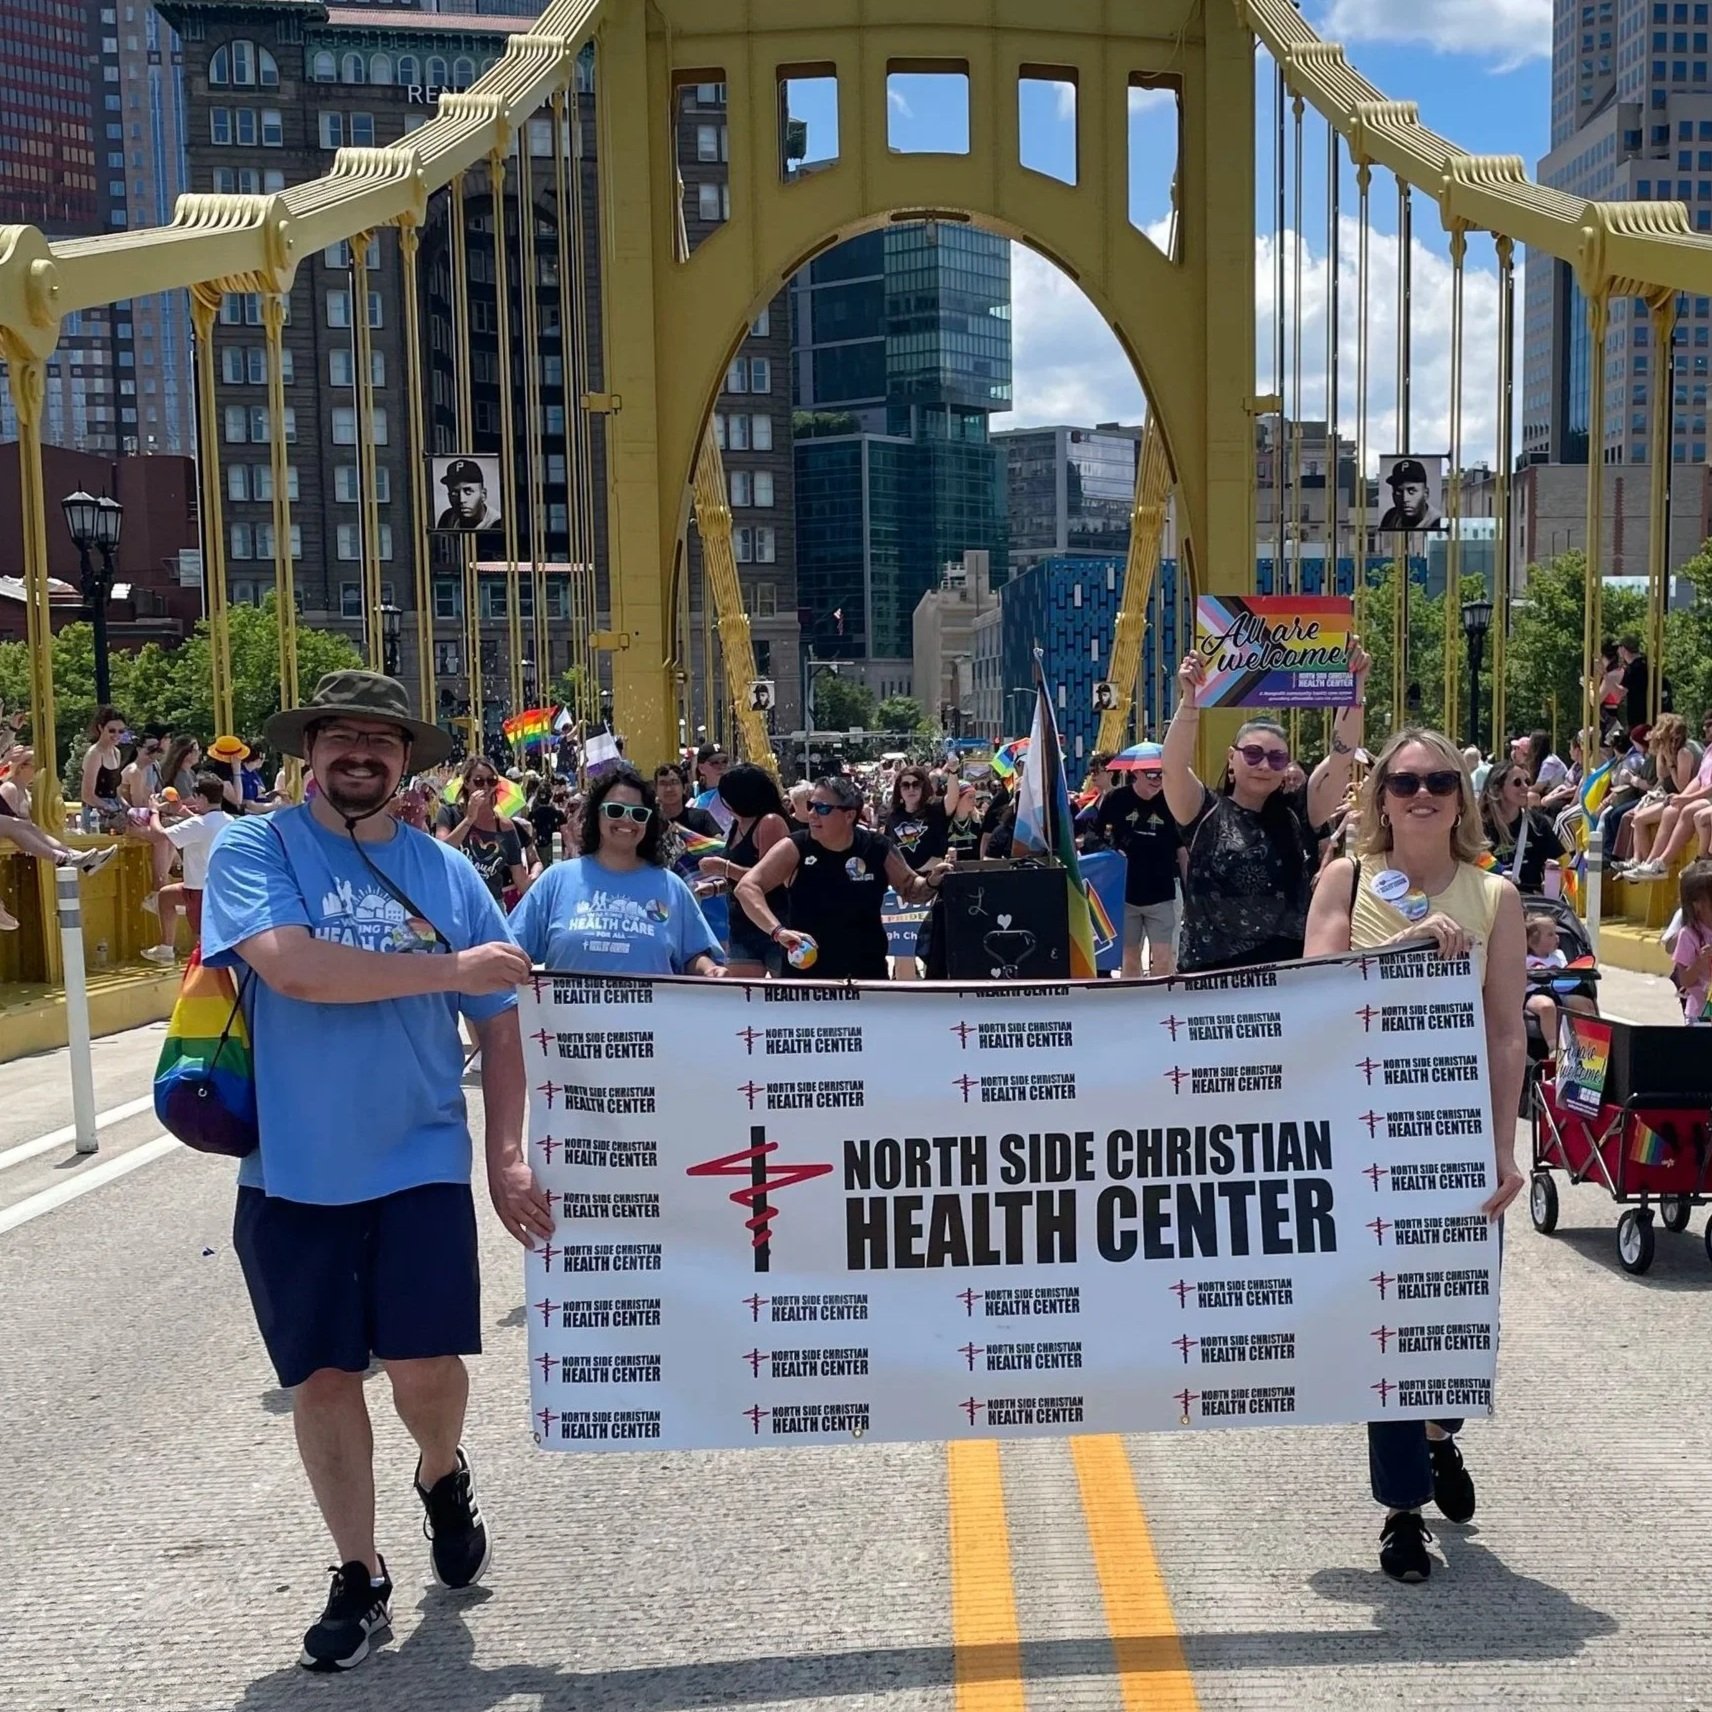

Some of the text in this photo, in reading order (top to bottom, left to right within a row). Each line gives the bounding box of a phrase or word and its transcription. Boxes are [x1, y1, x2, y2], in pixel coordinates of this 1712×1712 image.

[1201, 611, 1320, 655] All are
[1217, 631, 1351, 672] welcome!
[1298, 679, 1353, 687] HEALTH CENTER
[569, 917, 655, 937] HEALTH CARE
[1379, 954, 1406, 966] NORTH
[1408, 952, 1427, 963] SIDE
[1380, 961, 1471, 979] HEALTH CENTER
[1231, 972, 1277, 989] CENTER
[554, 989, 653, 1004] HEALTH CENTER
[764, 986, 811, 1002] HEALTH
[1382, 1002, 1473, 1016] NORTH SIDE CHRISTIAN
[978, 1021, 1072, 1033] NORTH SIDE CHRISTIAN
[1382, 1013, 1474, 1032] HEALTH CENTER
[766, 1027, 862, 1038] NORTH SIDE CHRISTIAN
[979, 1032, 1073, 1049] HEALTH CENTER
[766, 1037, 862, 1054] HEALTH CENTER
[1383, 1055, 1477, 1069] NORTH SIDE CHRISTIAN
[981, 1073, 1075, 1087] NORTH SIDE CHRISTIAN
[1192, 1065, 1282, 1078] NORTH SIDE CHRISTIAN
[1384, 1066, 1478, 1085] HEALTH CENTER
[767, 1080, 864, 1093] NORTH SIDE CHRISTIAN
[982, 1084, 1076, 1102] HEALTH CENTER
[1192, 1075, 1282, 1094] HEALTH CENTER
[767, 1092, 864, 1109] HEALTH CENTER
[843, 1120, 1333, 1190] NORTH SIDE CHRISTIAN
[1390, 1162, 1485, 1175] NORTH SIDE CHRISTIAN
[1392, 1173, 1486, 1191] HEALTH CENTER
[563, 1192, 659, 1204] NORTH SIDE CHRISTIAN
[563, 1204, 660, 1218] HEALTH CENTER
[846, 1178, 1337, 1270] HEALTH CENTER
[1394, 1216, 1487, 1229] NORTH SIDE CHRISTIAN
[1395, 1226, 1487, 1245] HEALTH CENTER
[564, 1244, 662, 1256] NORTH SIDE CHRISTIAN
[564, 1255, 661, 1272] HEALTH CENTER
[1397, 1269, 1489, 1283] NORTH SIDE CHRISTIAN
[985, 1287, 1080, 1300] NORTH SIDE CHRISTIAN
[1197, 1278, 1292, 1292] NORTH SIDE CHRISTIAN
[1398, 1280, 1489, 1299] HEALTH CENTER
[563, 1298, 660, 1311] NORTH SIDE CHRISTIAN
[772, 1294, 868, 1306] NORTH SIDE CHRISTIAN
[985, 1298, 1080, 1316] HEALTH CENTER
[1198, 1289, 1293, 1308] HEALTH CENTER
[563, 1310, 660, 1328] HEALTH CENTER
[772, 1305, 868, 1322] HEALTH CENTER
[986, 1342, 1082, 1354] NORTH SIDE CHRISTIAN
[1200, 1333, 1295, 1347] NORTH SIDE CHRISTIAN
[562, 1355, 661, 1367] NORTH SIDE CHRISTIAN
[772, 1348, 868, 1361] NORTH SIDE CHRISTIAN
[987, 1353, 1082, 1371] HEALTH CENTER
[1201, 1344, 1295, 1363] HEALTH CENTER
[562, 1366, 660, 1383] HEALTH CENTER
[772, 1359, 868, 1378] HEALTH CENTER
